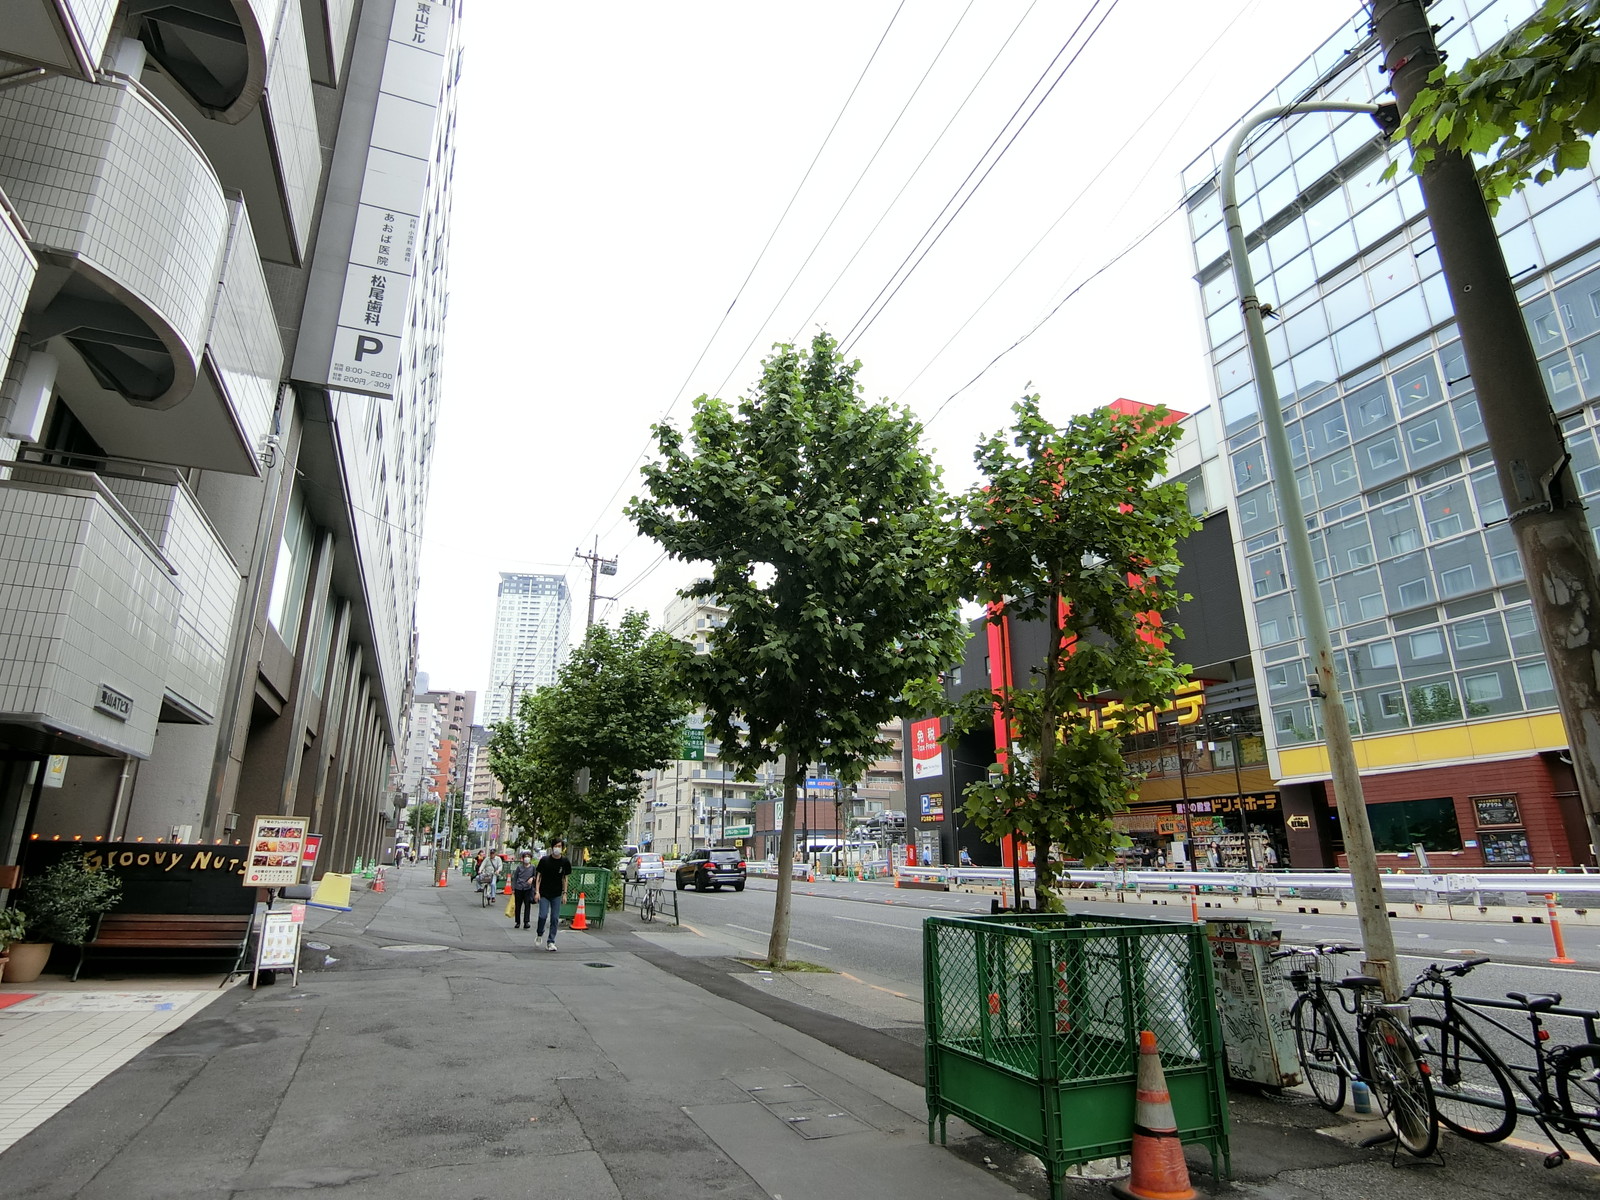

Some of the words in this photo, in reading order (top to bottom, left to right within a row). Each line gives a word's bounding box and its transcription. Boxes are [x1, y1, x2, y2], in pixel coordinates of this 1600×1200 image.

[412, 2, 431, 43] 東山ビル
[376, 213, 395, 266] あおば医院
[364, 274, 386, 326] 松尾歯科
[354, 335, 383, 362] P
[922, 797, 928, 812] P
